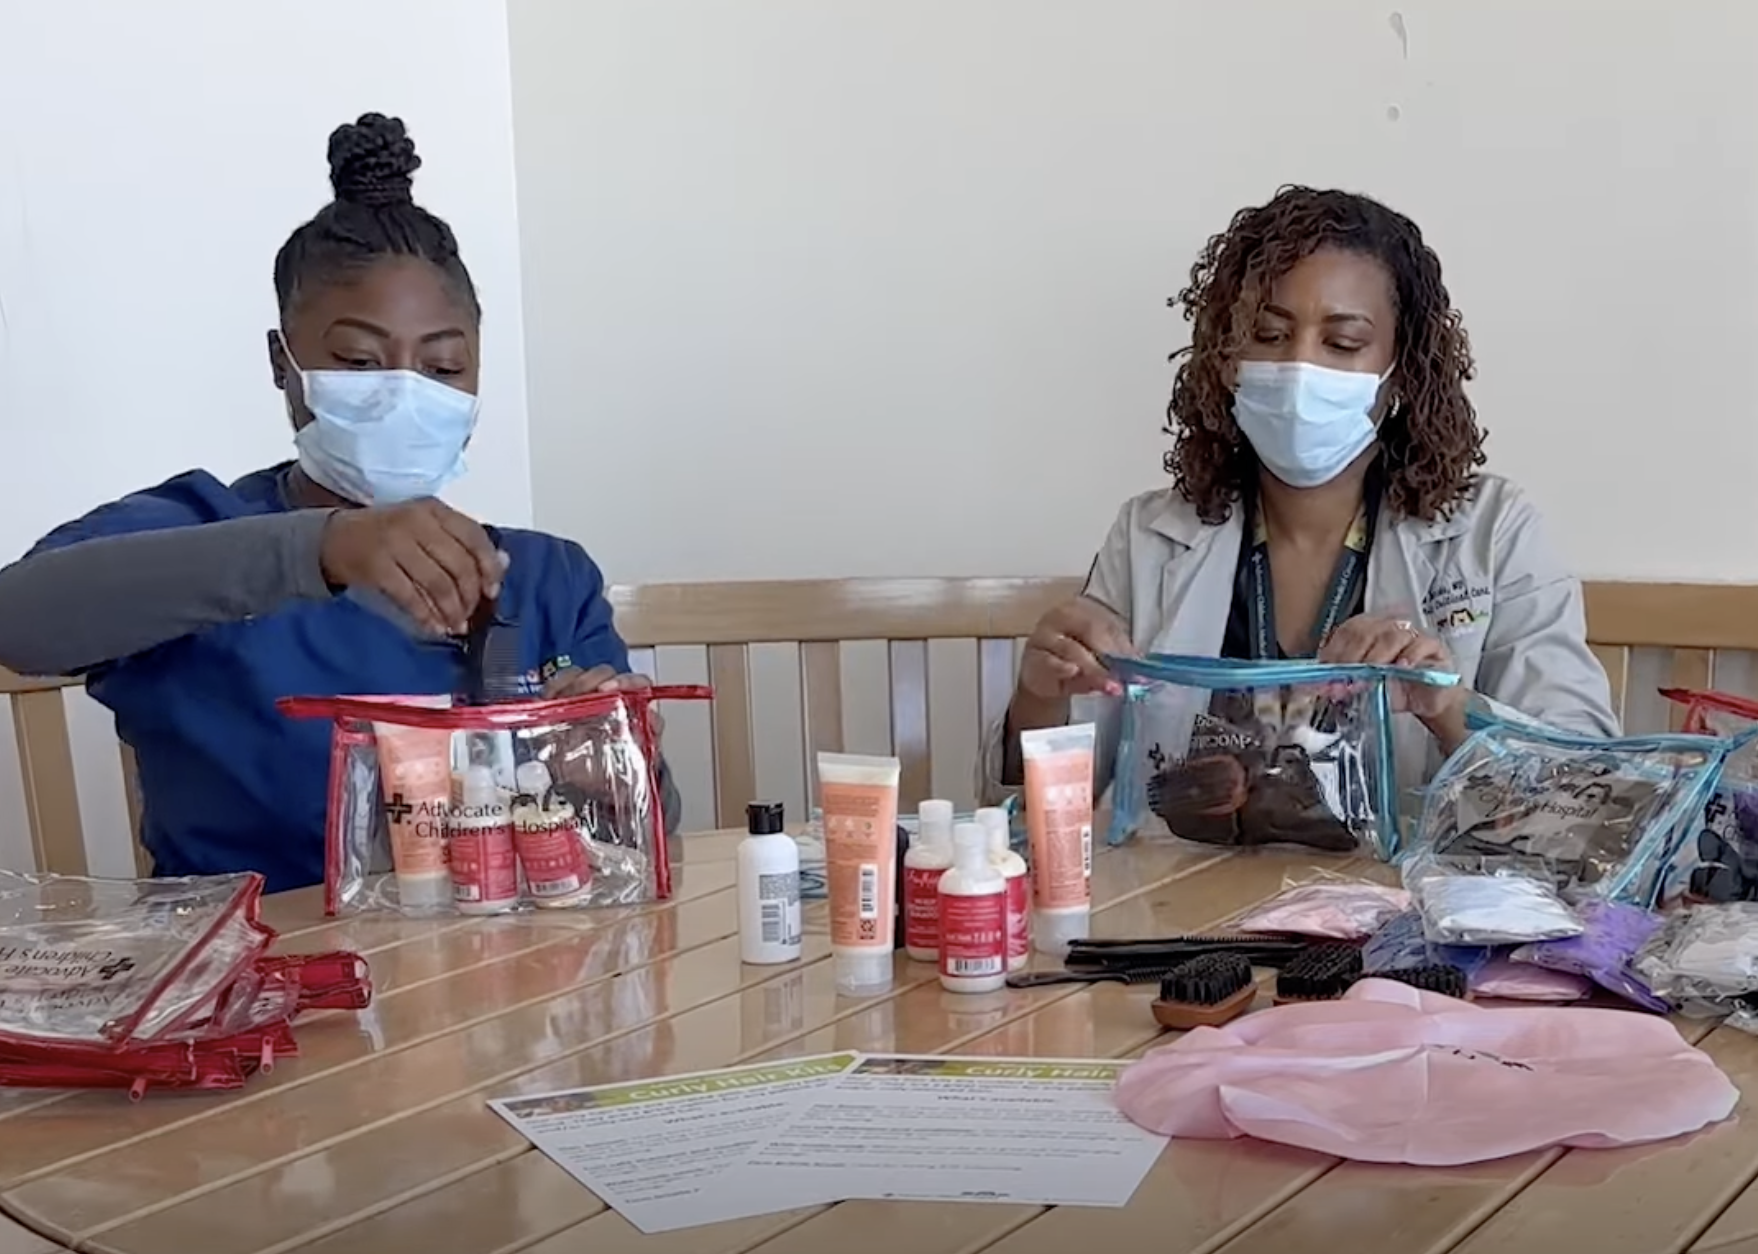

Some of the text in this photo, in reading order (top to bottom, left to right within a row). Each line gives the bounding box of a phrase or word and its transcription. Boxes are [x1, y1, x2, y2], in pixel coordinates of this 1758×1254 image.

[417, 801, 503, 818] Advocate
[415, 821, 506, 838] Children's
[20, 949, 113, 965] Children's
[4, 965, 97, 979] Advocate
[964, 1065, 1116, 1079] Curly Hair
[629, 1081, 707, 1101] Curly
[716, 1071, 776, 1089] Hair
[785, 1063, 842, 1078] Kits
